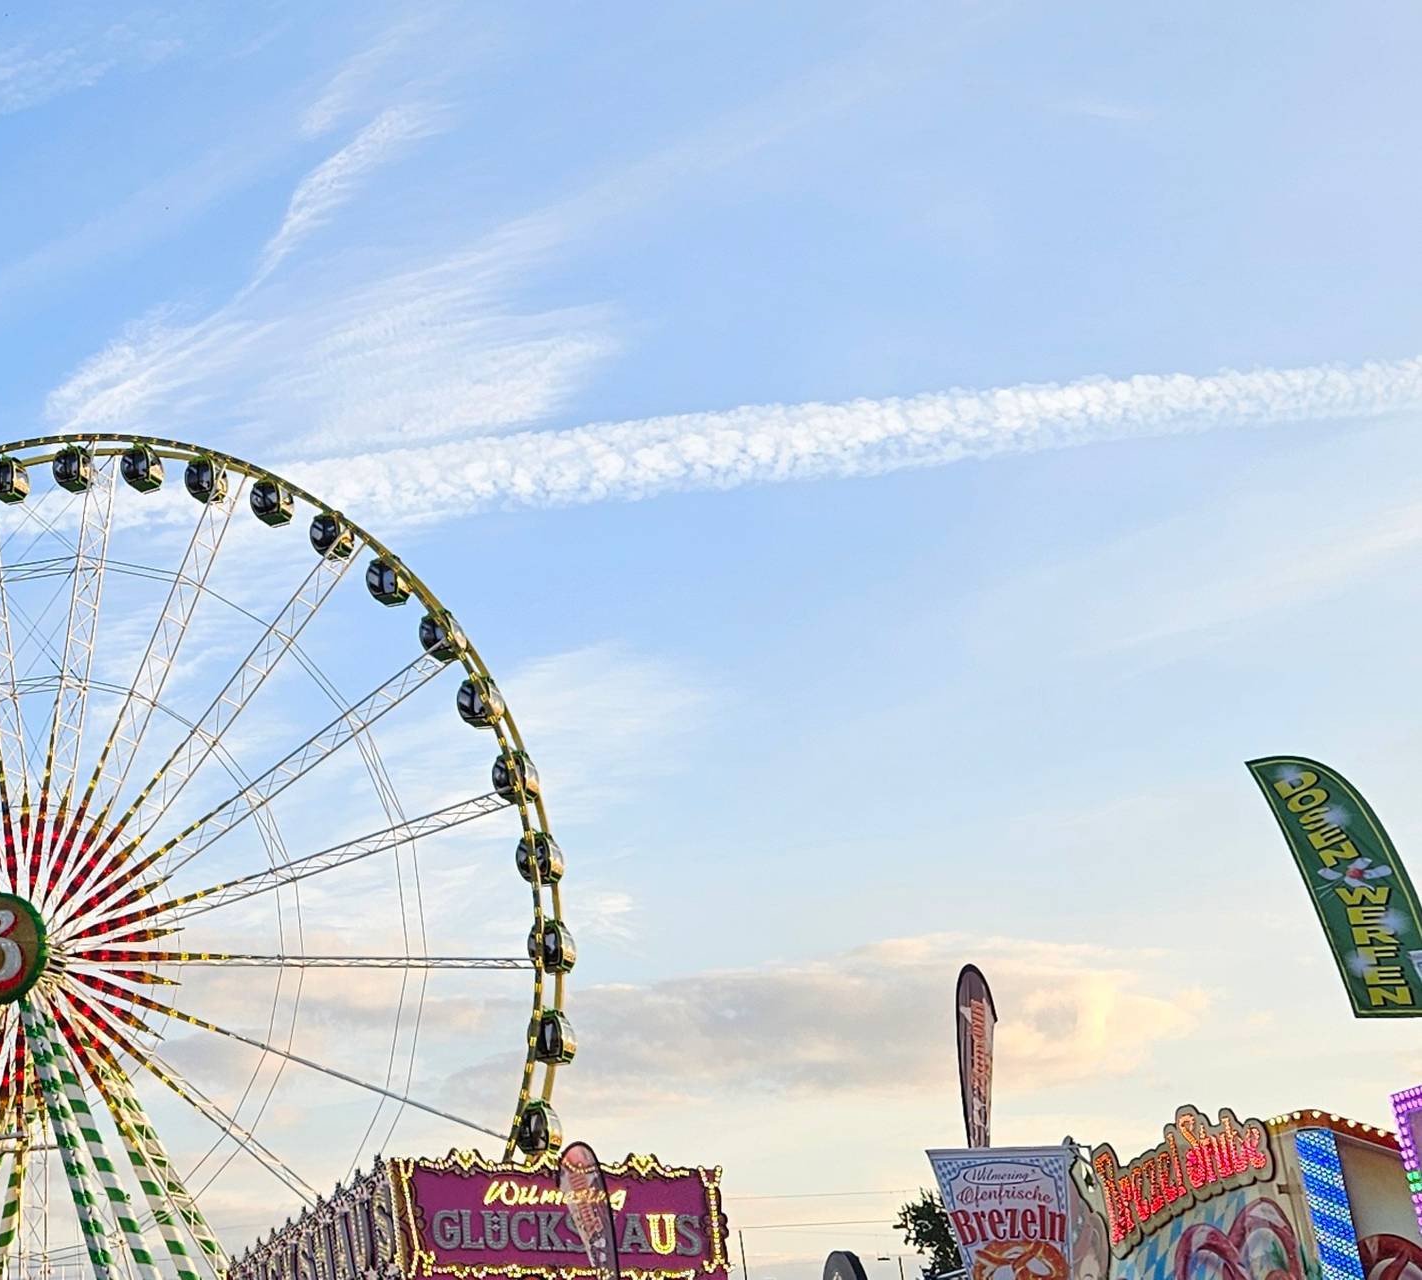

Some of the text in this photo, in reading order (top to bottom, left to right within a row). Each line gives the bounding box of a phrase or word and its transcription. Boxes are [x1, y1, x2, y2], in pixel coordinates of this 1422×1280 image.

[1274, 771, 1415, 1007] DOSEN WERFEN
[956, 1184, 1054, 1207] Ofenfrische
[432, 1208, 703, 1257] GLÜCKSAUS
[950, 1204, 1068, 1246] Brezeln
